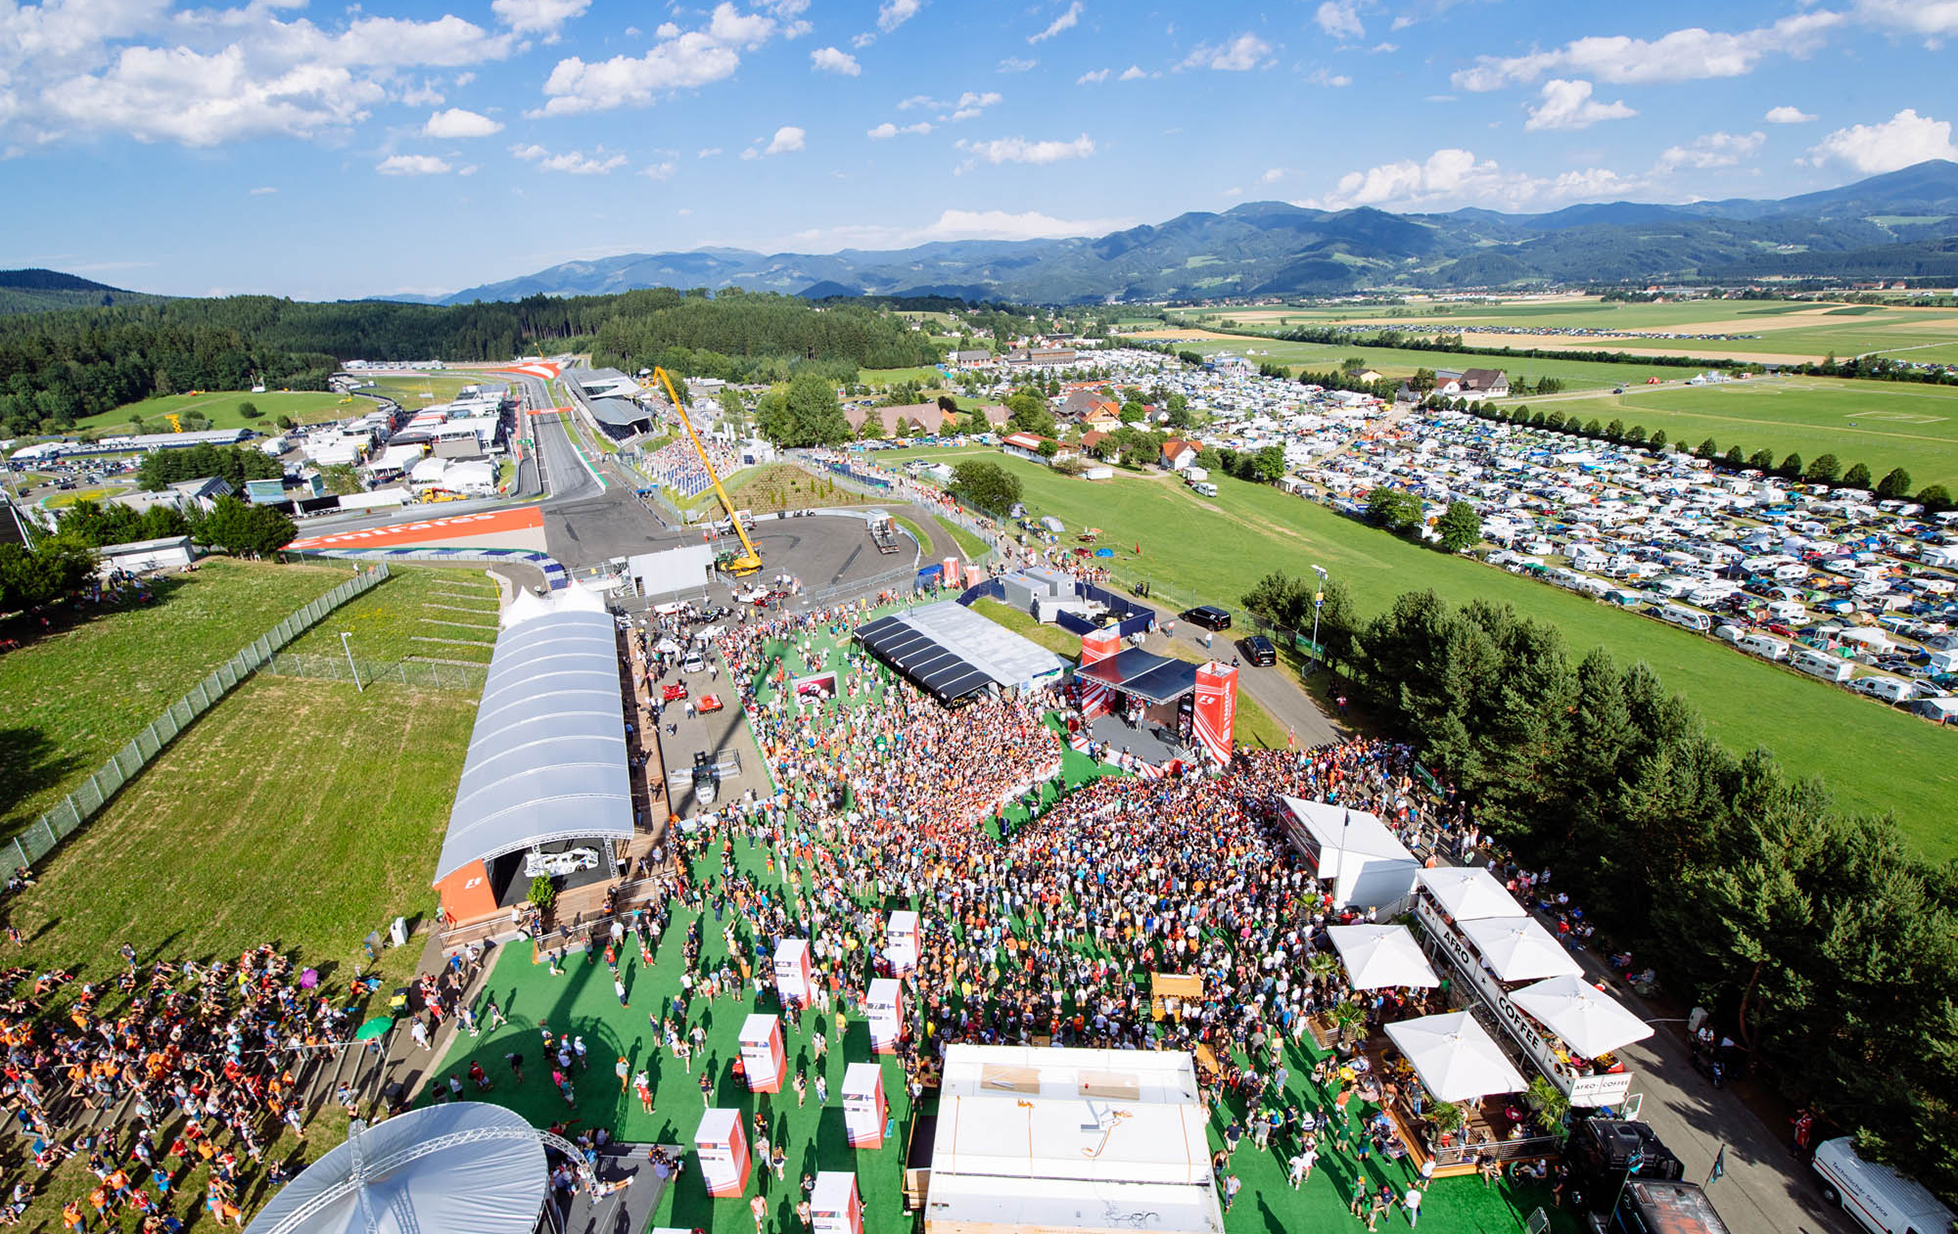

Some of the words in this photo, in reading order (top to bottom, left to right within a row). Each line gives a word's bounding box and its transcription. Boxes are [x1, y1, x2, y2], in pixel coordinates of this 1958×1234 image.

[1444, 931, 1469, 964] AFRO
[1499, 997, 1540, 1049] COFFEE
[1603, 1080, 1628, 1088] COFFEE
[1866, 1194, 1888, 1217] Service
